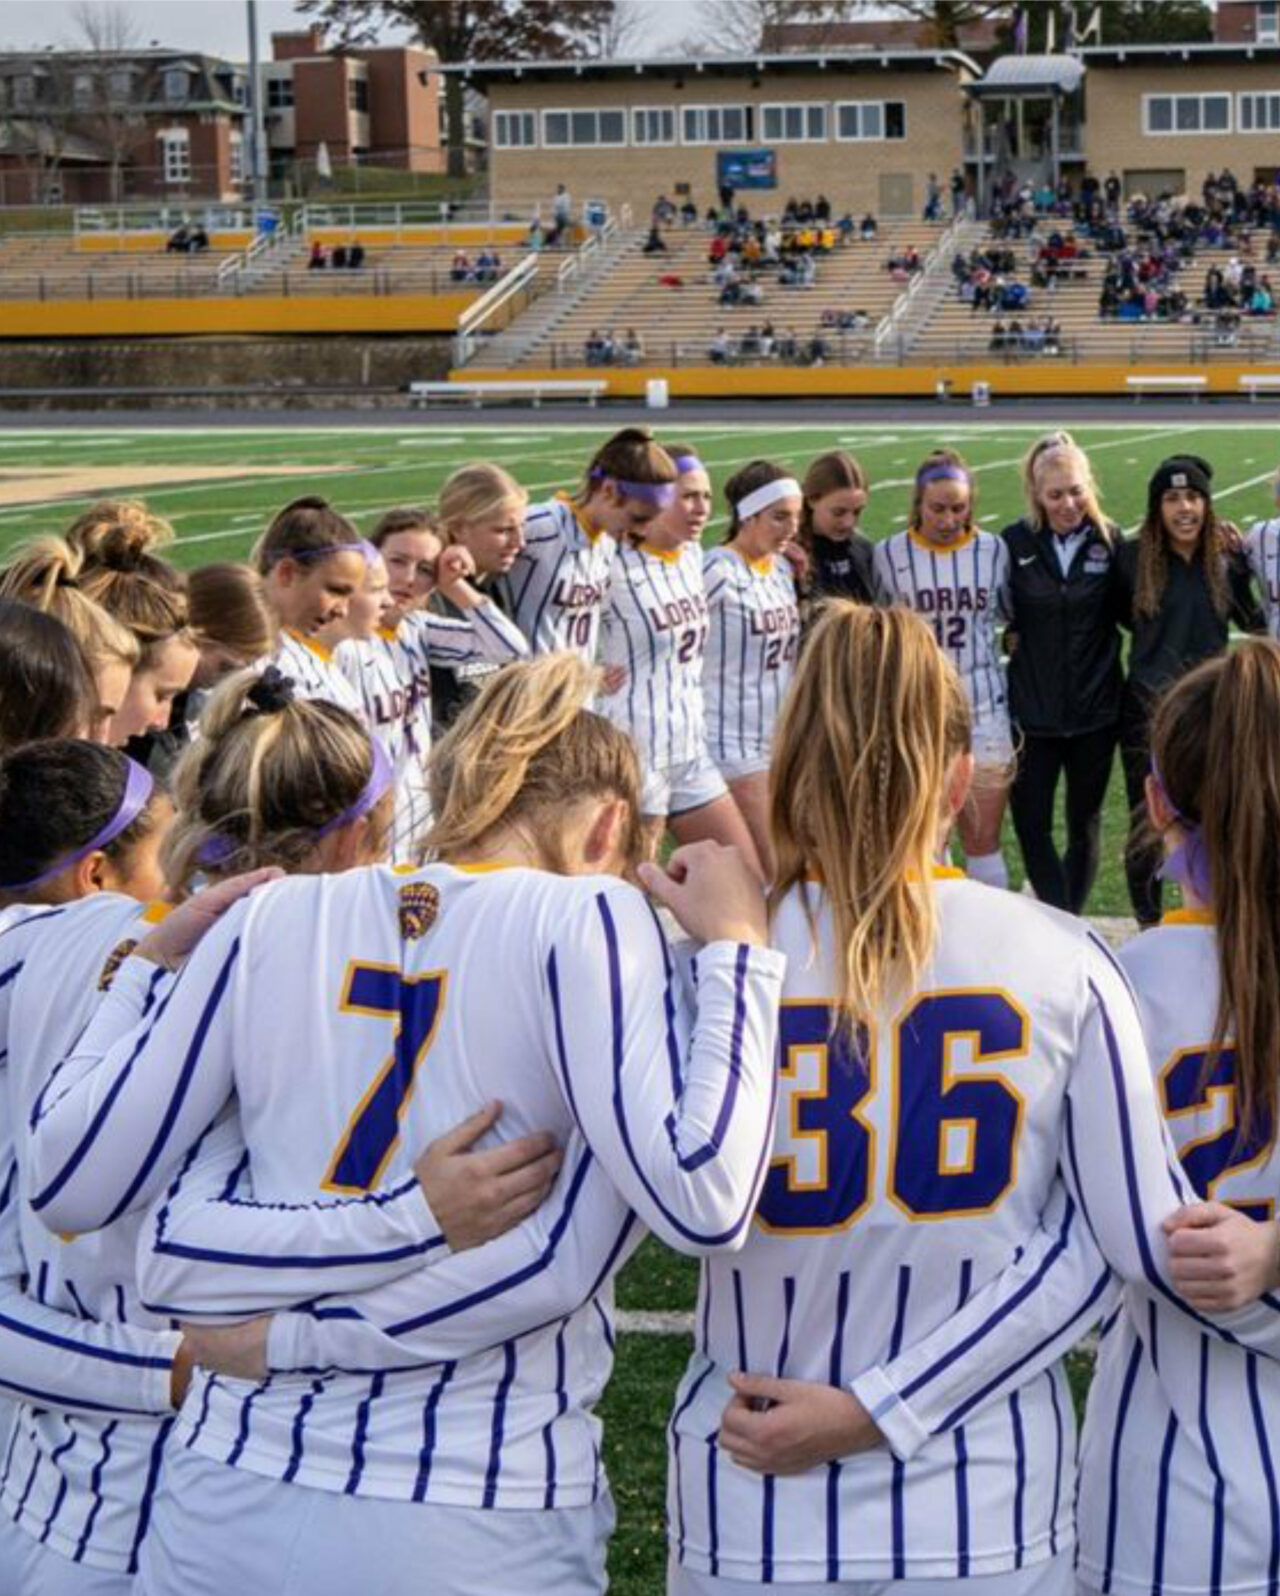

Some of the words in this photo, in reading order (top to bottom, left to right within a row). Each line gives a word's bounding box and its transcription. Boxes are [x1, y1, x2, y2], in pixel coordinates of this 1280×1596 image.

[565, 611, 592, 647] 10
[319, 956, 449, 1196] 7
[754, 985, 1032, 1237] 36
